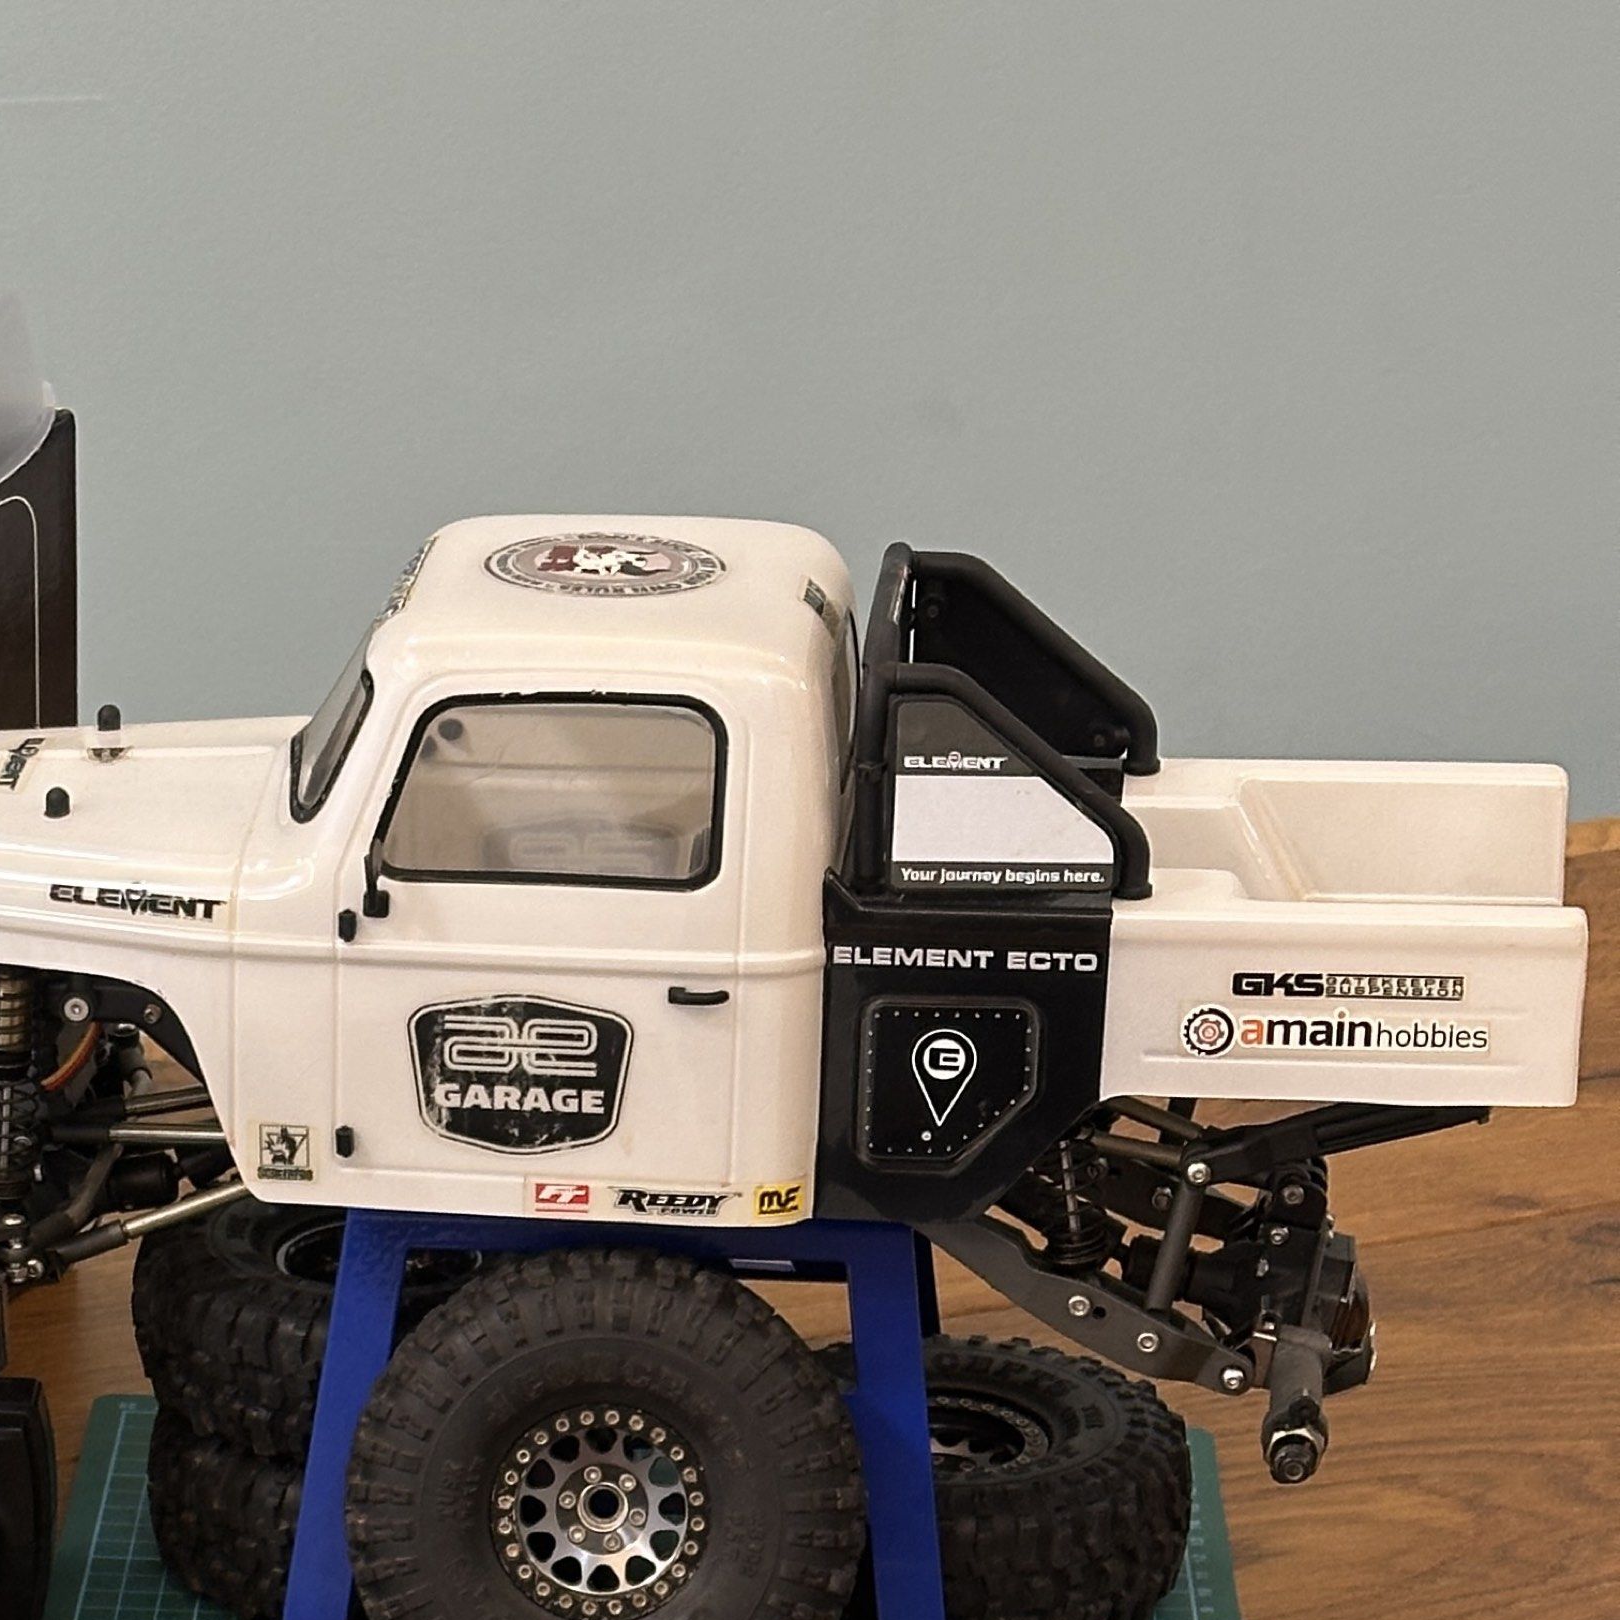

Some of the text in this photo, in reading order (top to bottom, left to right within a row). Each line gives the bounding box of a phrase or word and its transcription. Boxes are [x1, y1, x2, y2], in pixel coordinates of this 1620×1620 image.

[903, 752, 1008, 770] ELEMENT
[901, 868, 1105, 884] Your journey begins here.
[50, 884, 226, 921] ELEMENT
[833, 946, 1098, 972] ELEMENT ECTO
[1232, 973, 1323, 997] GKS
[1325, 976, 1464, 987] GATEKEEPER
[435, 1083, 604, 1114] GARAGE
[618, 1190, 728, 1212] REEDY
